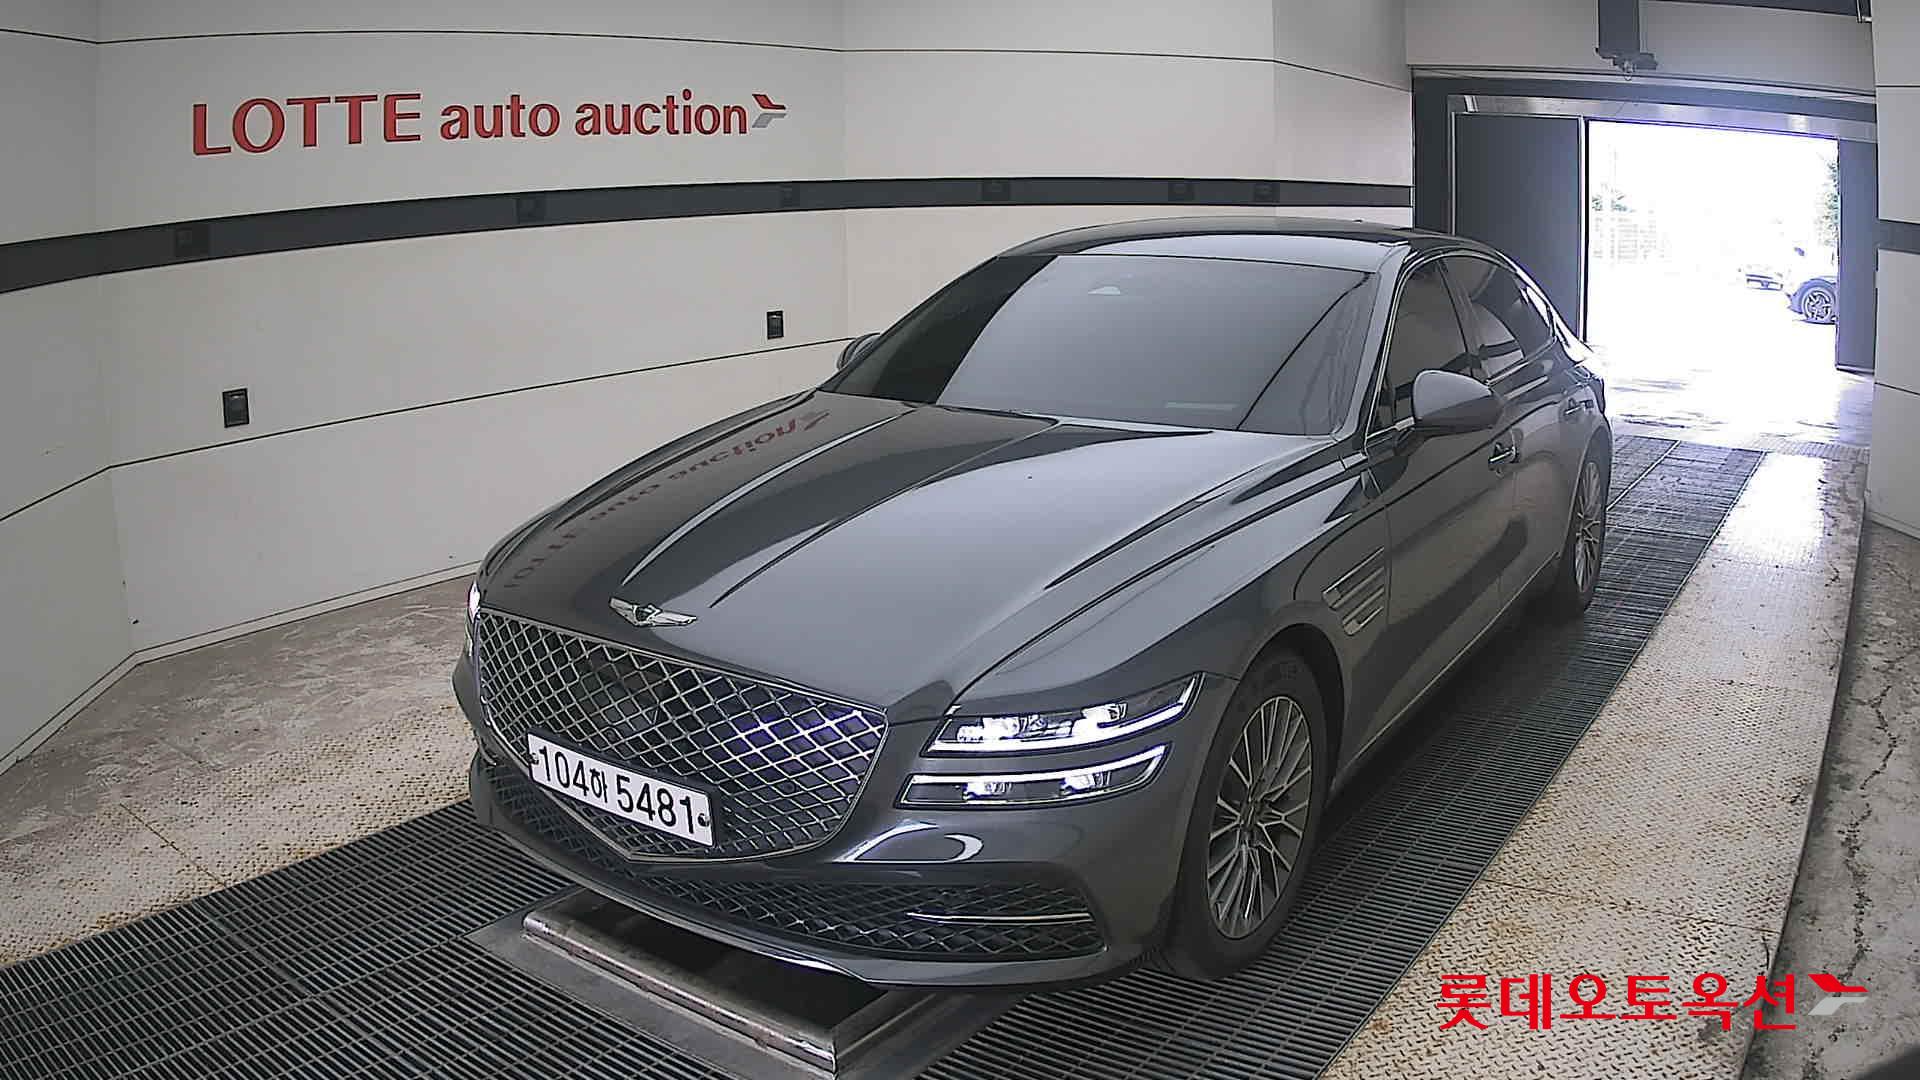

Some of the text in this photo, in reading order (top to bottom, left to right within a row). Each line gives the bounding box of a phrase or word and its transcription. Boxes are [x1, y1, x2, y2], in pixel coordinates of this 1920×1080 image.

[192, 88, 748, 155] LOTTE auto auction
[539, 746, 694, 835] 104하 5481
